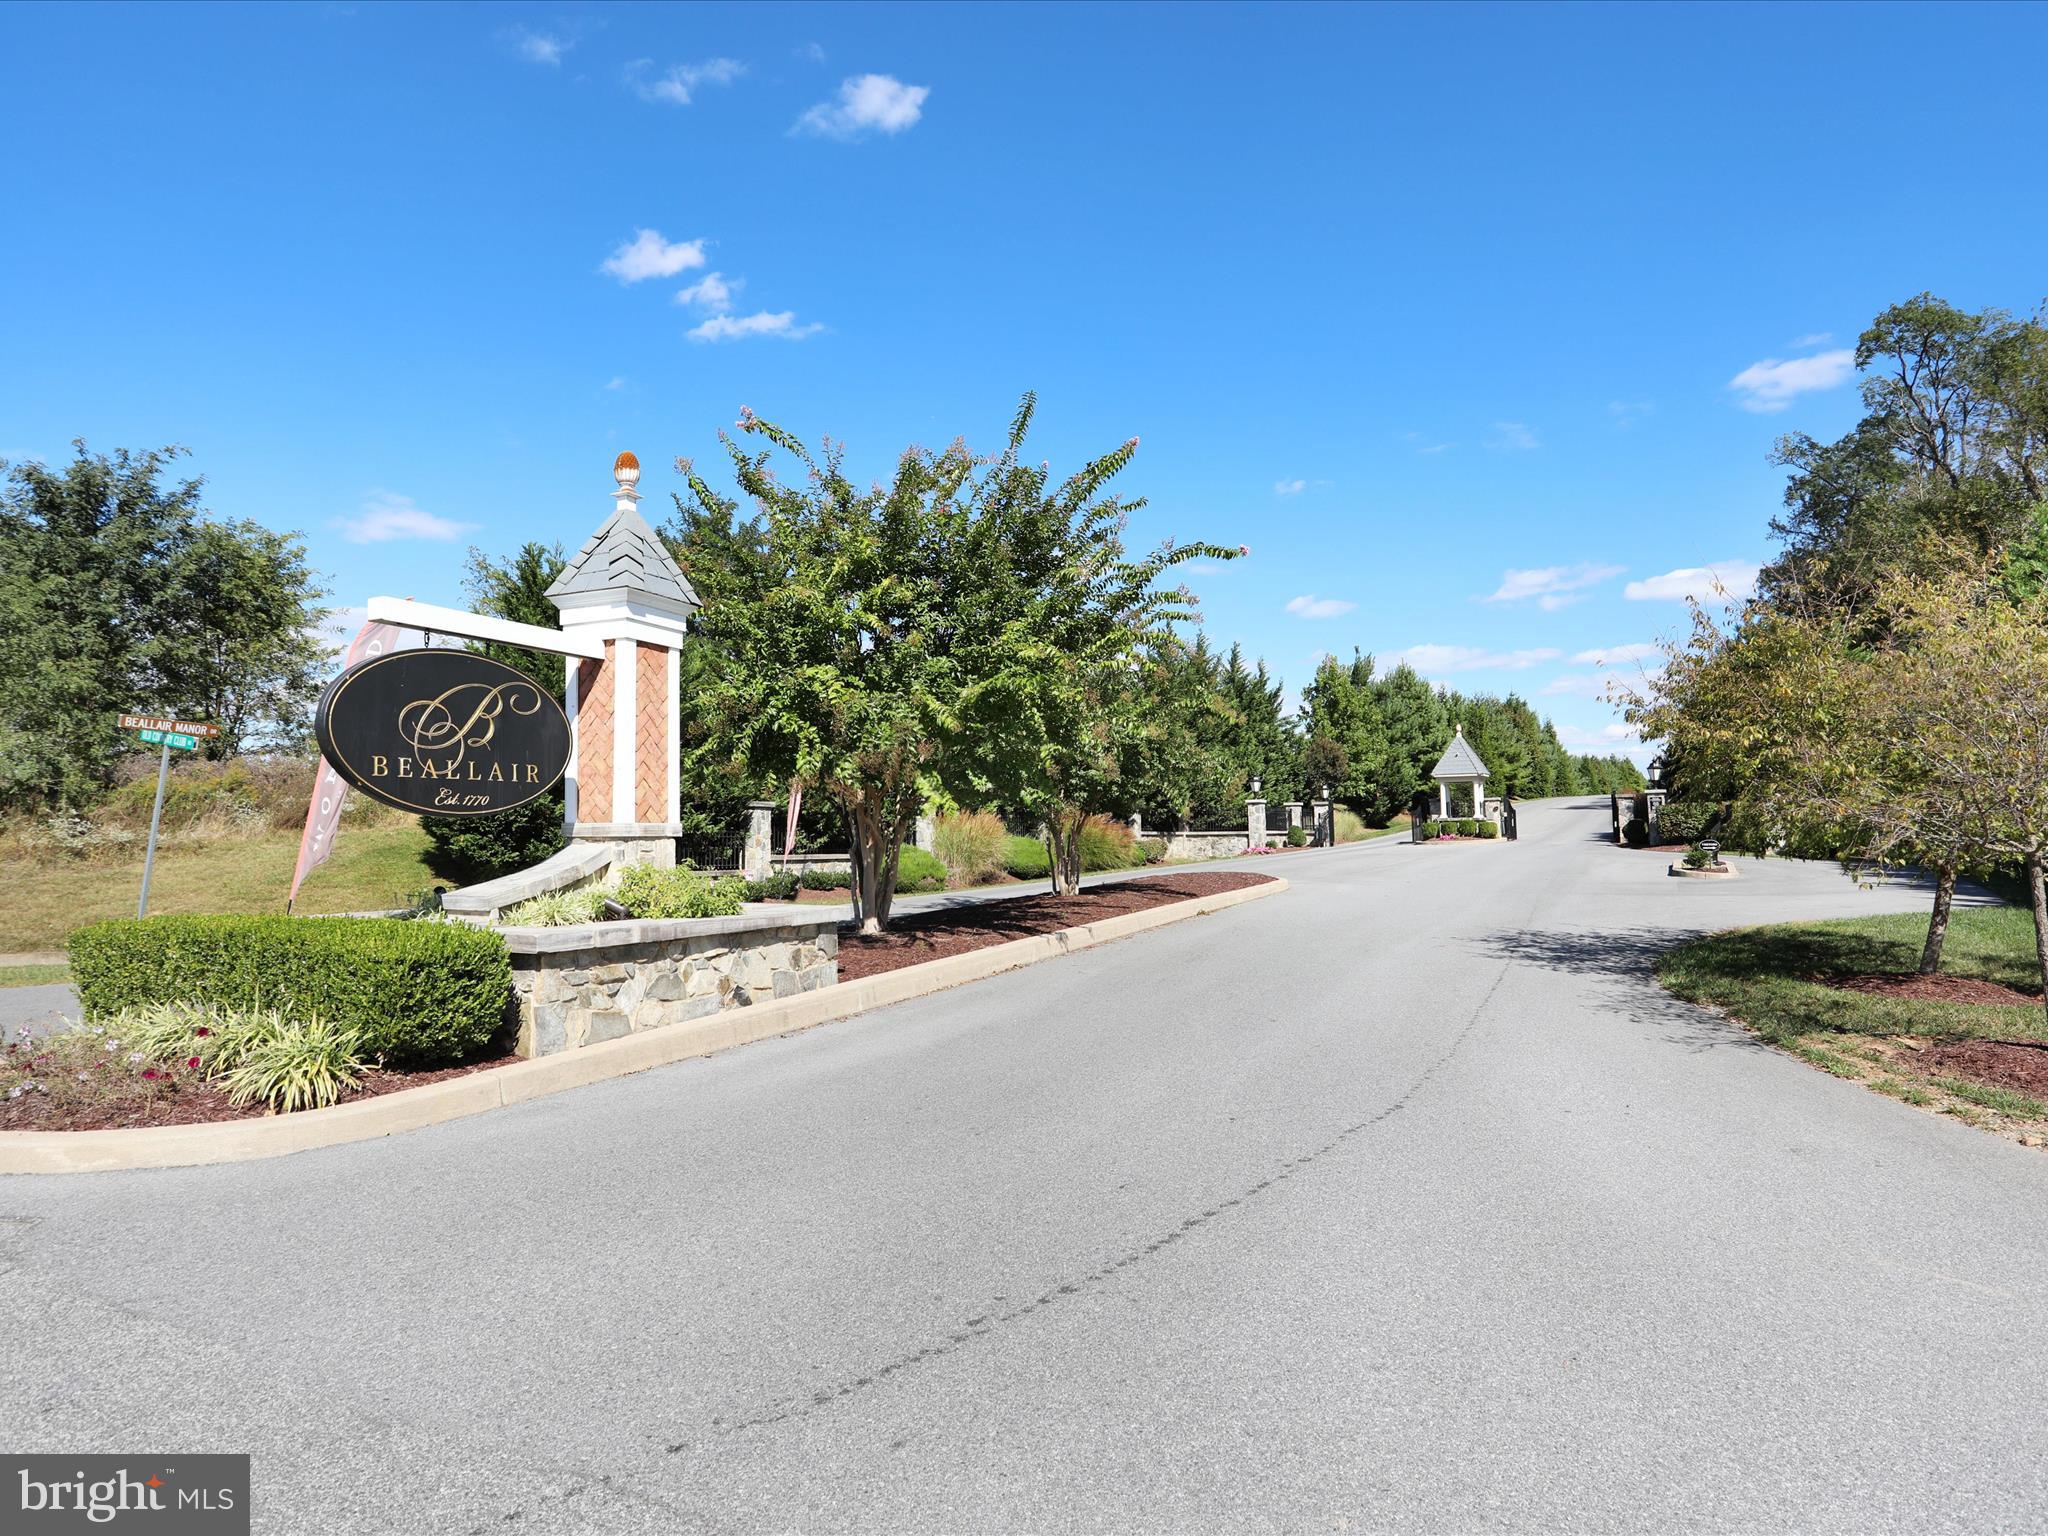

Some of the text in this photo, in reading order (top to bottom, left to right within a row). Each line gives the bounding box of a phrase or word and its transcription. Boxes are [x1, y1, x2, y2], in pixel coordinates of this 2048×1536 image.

[125, 716, 173, 732] BEALLAIR
[175, 723, 207, 735] MANOR
[371, 755, 540, 783] BEALLAIR
[435, 787, 490, 806] Est. 1770
